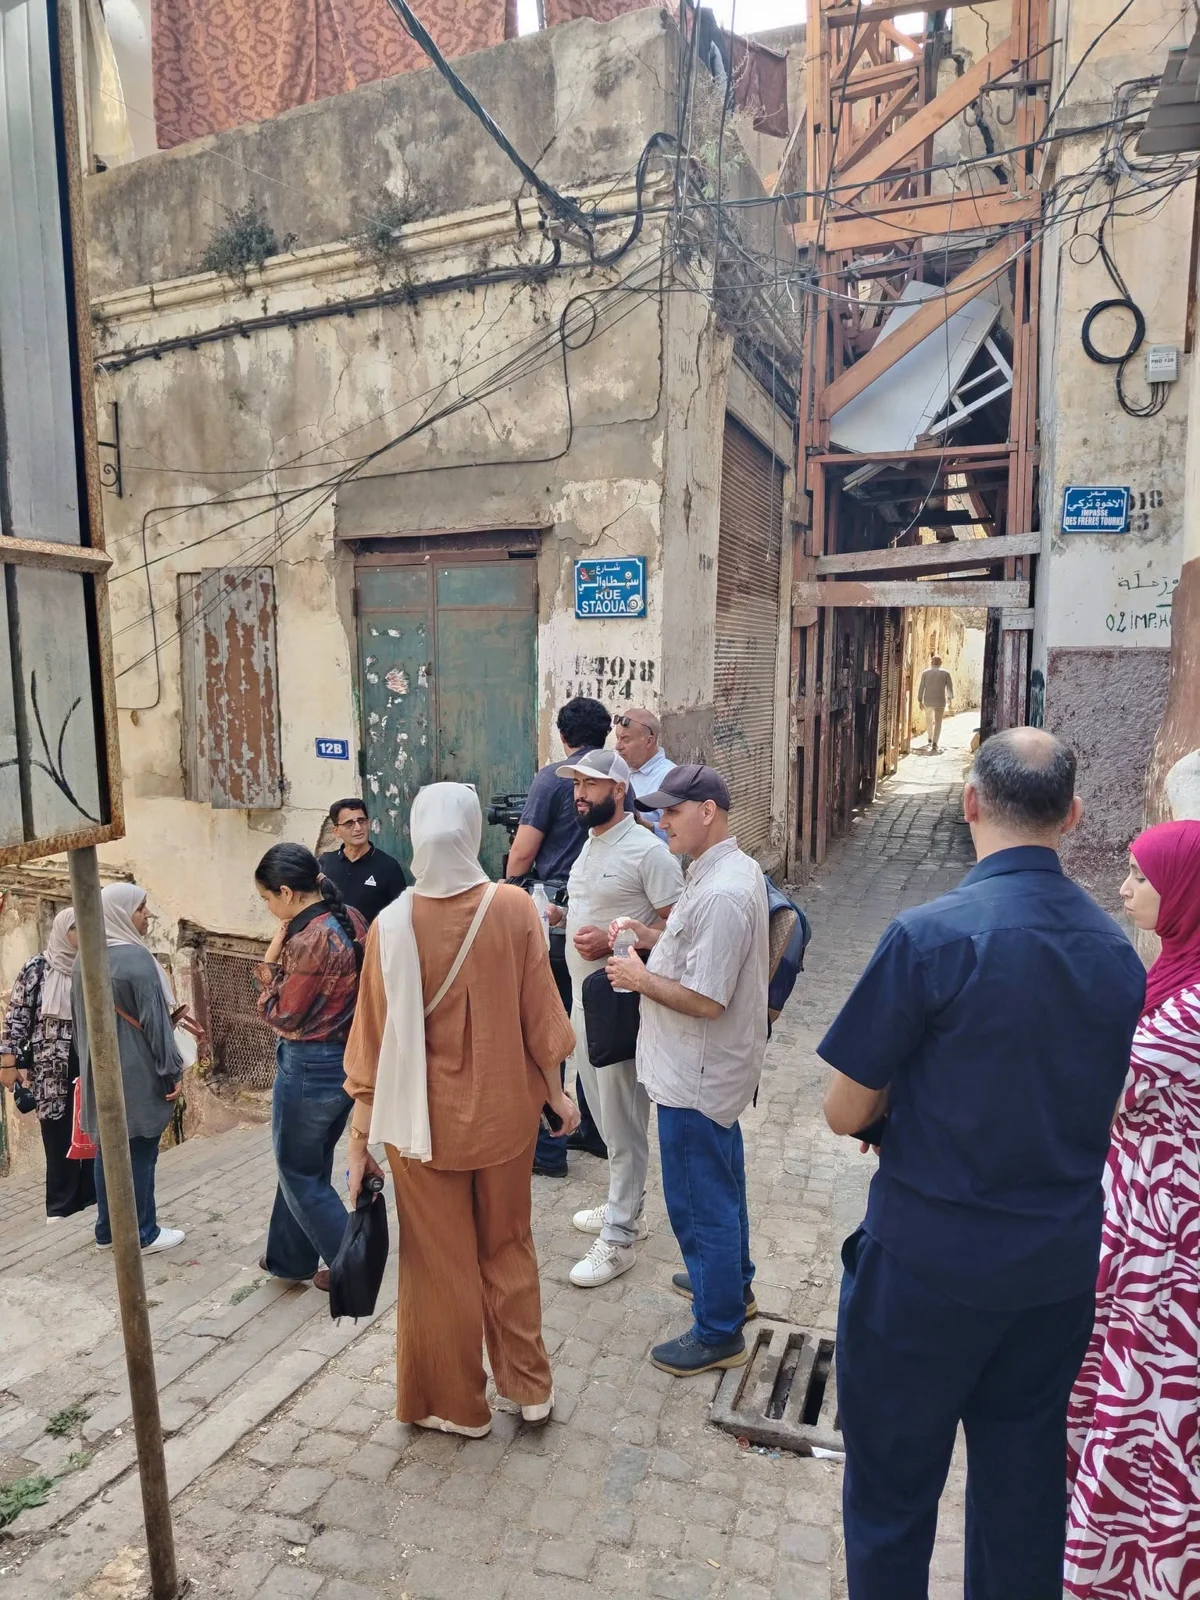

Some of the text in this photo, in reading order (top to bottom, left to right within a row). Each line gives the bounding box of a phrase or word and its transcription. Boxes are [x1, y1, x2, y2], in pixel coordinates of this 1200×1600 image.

[1086, 490, 1107, 498] ممر
[1081, 509, 1109, 517] IMPASSE
[1065, 516, 1077, 526] DES
[595, 562, 621, 575] شارع
[595, 589, 622, 600] RUE
[582, 599, 632, 613] STAOUA
[318, 742, 343, 754] 12B
